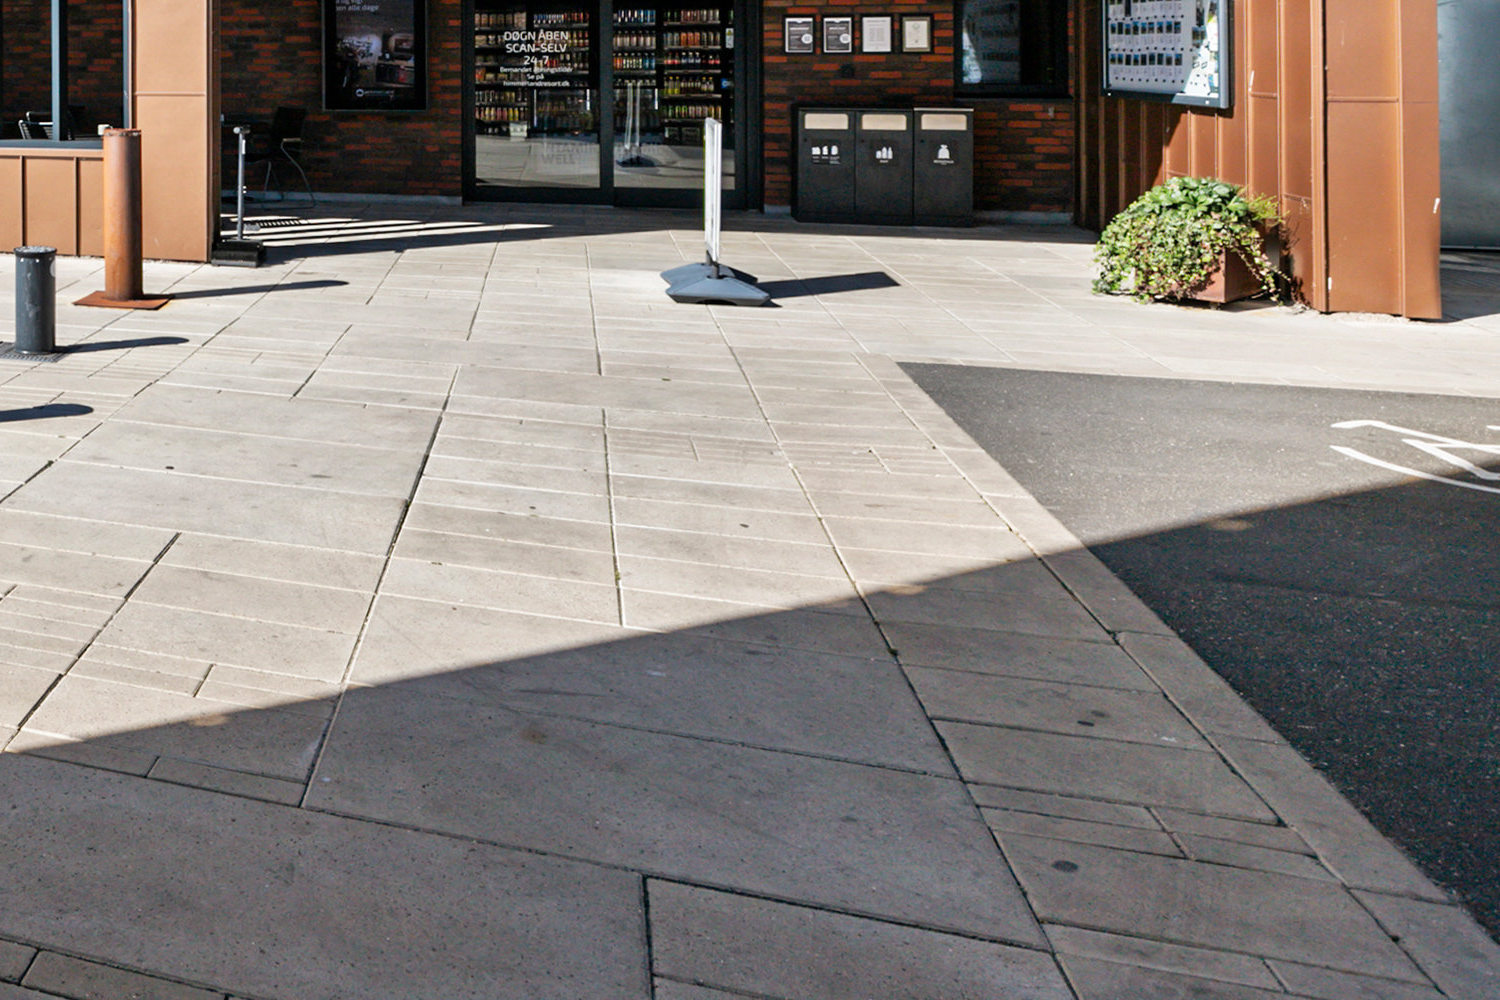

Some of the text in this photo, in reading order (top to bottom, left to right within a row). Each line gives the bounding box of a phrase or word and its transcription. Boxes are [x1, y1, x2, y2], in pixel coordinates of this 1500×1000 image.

[503, 28, 569, 41] DØGN ÅBEN
[505, 43, 567, 53] SCAN-SELV
[523, 55, 549, 65] 24-7
